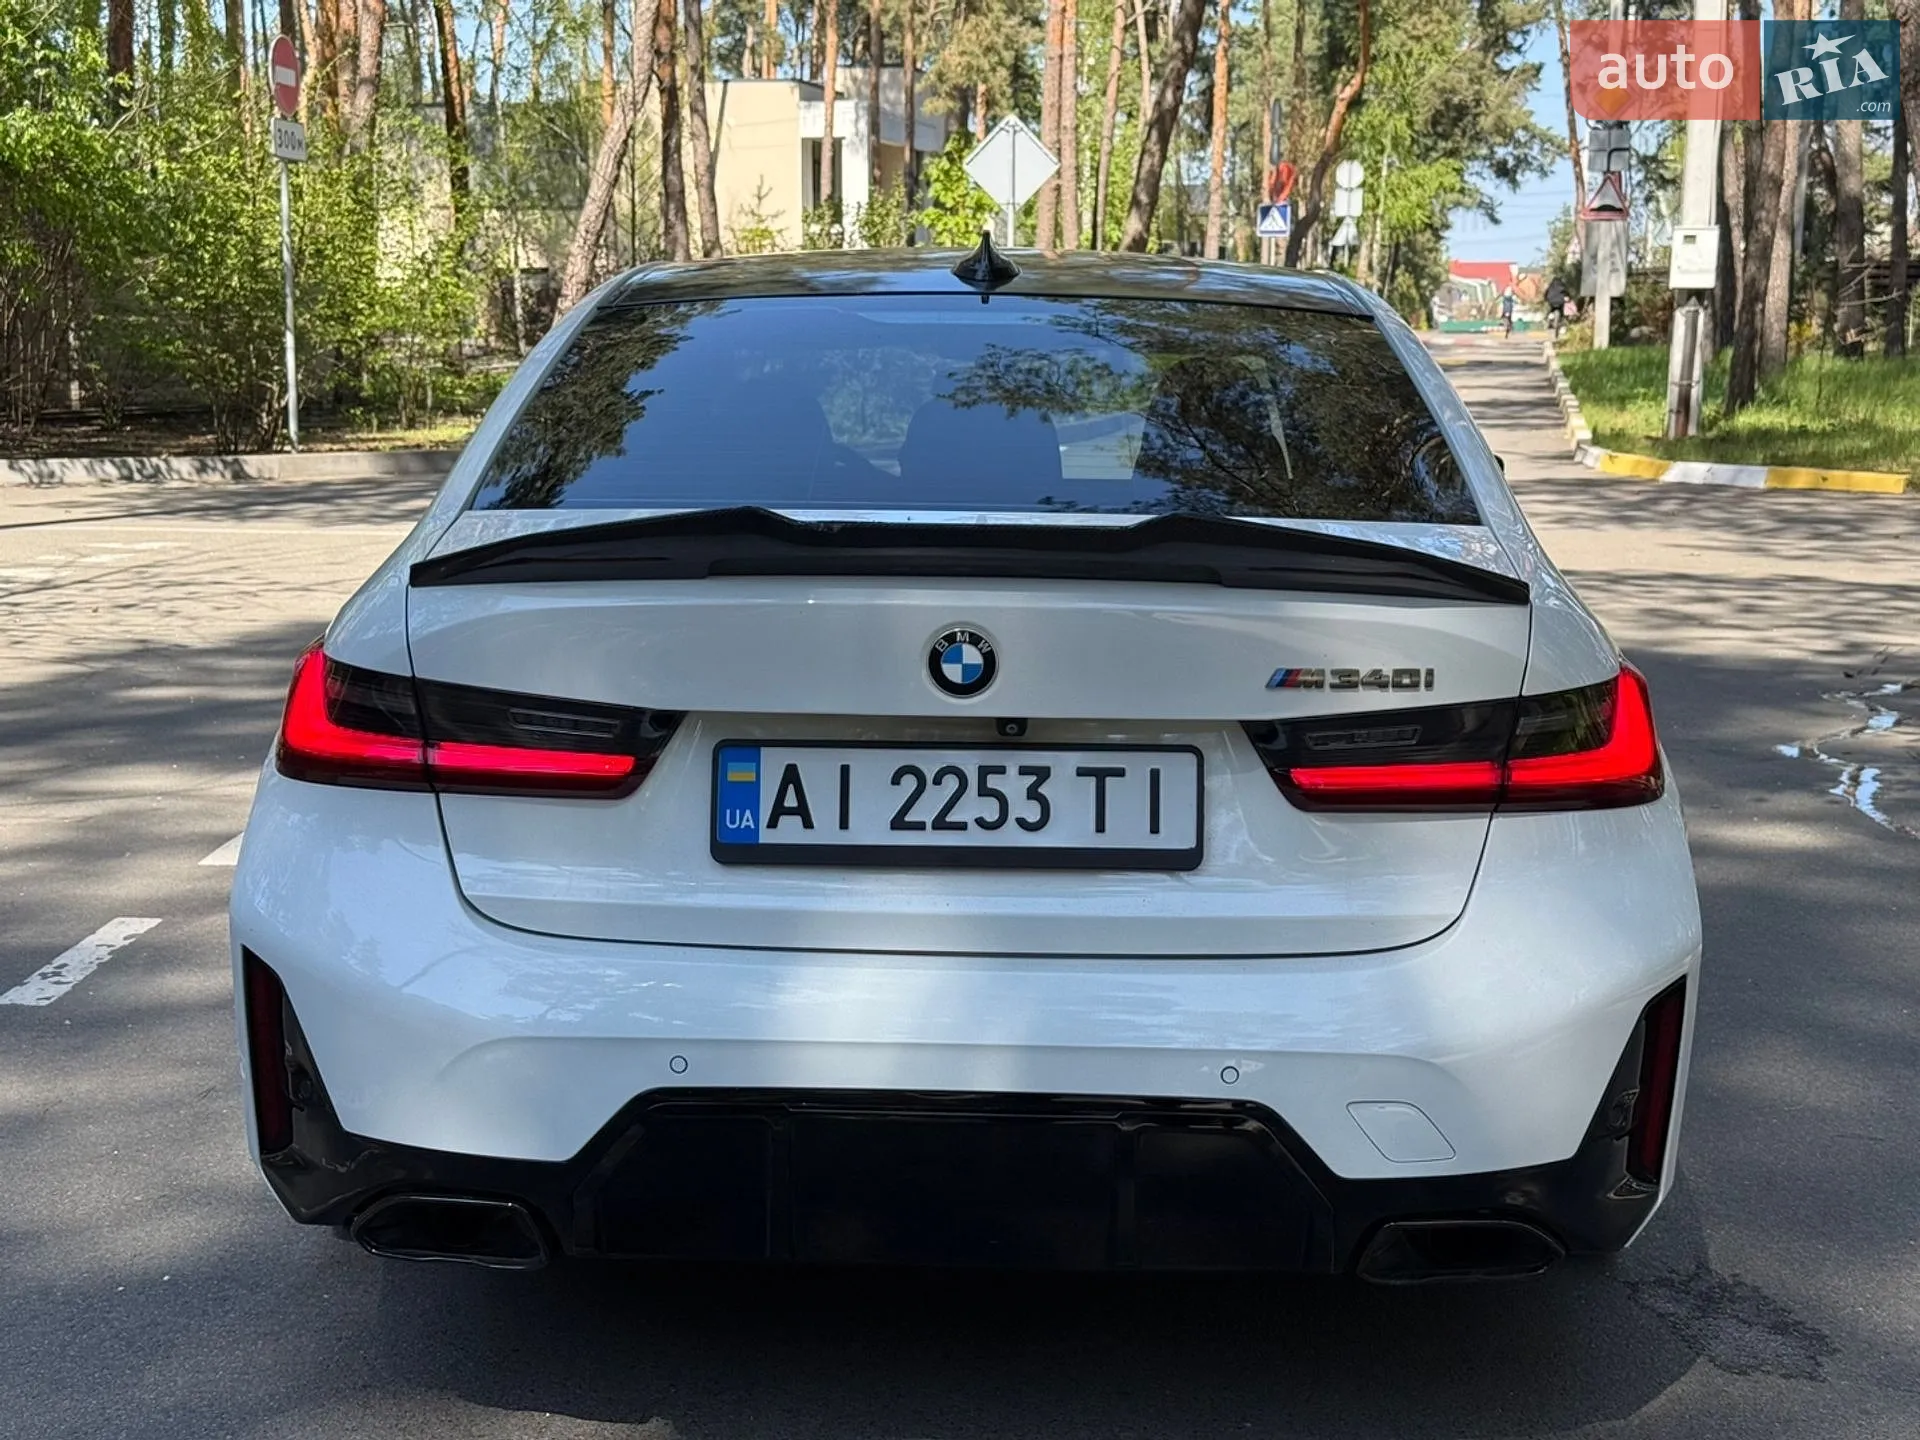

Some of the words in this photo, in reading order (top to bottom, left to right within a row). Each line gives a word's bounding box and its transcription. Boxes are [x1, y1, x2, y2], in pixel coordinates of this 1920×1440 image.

[935, 632, 992, 654] BMW
[766, 763, 851, 830] AI
[890, 765, 1052, 832] 2253
[1076, 766, 1161, 835] TI
[725, 808, 755, 829] UA
